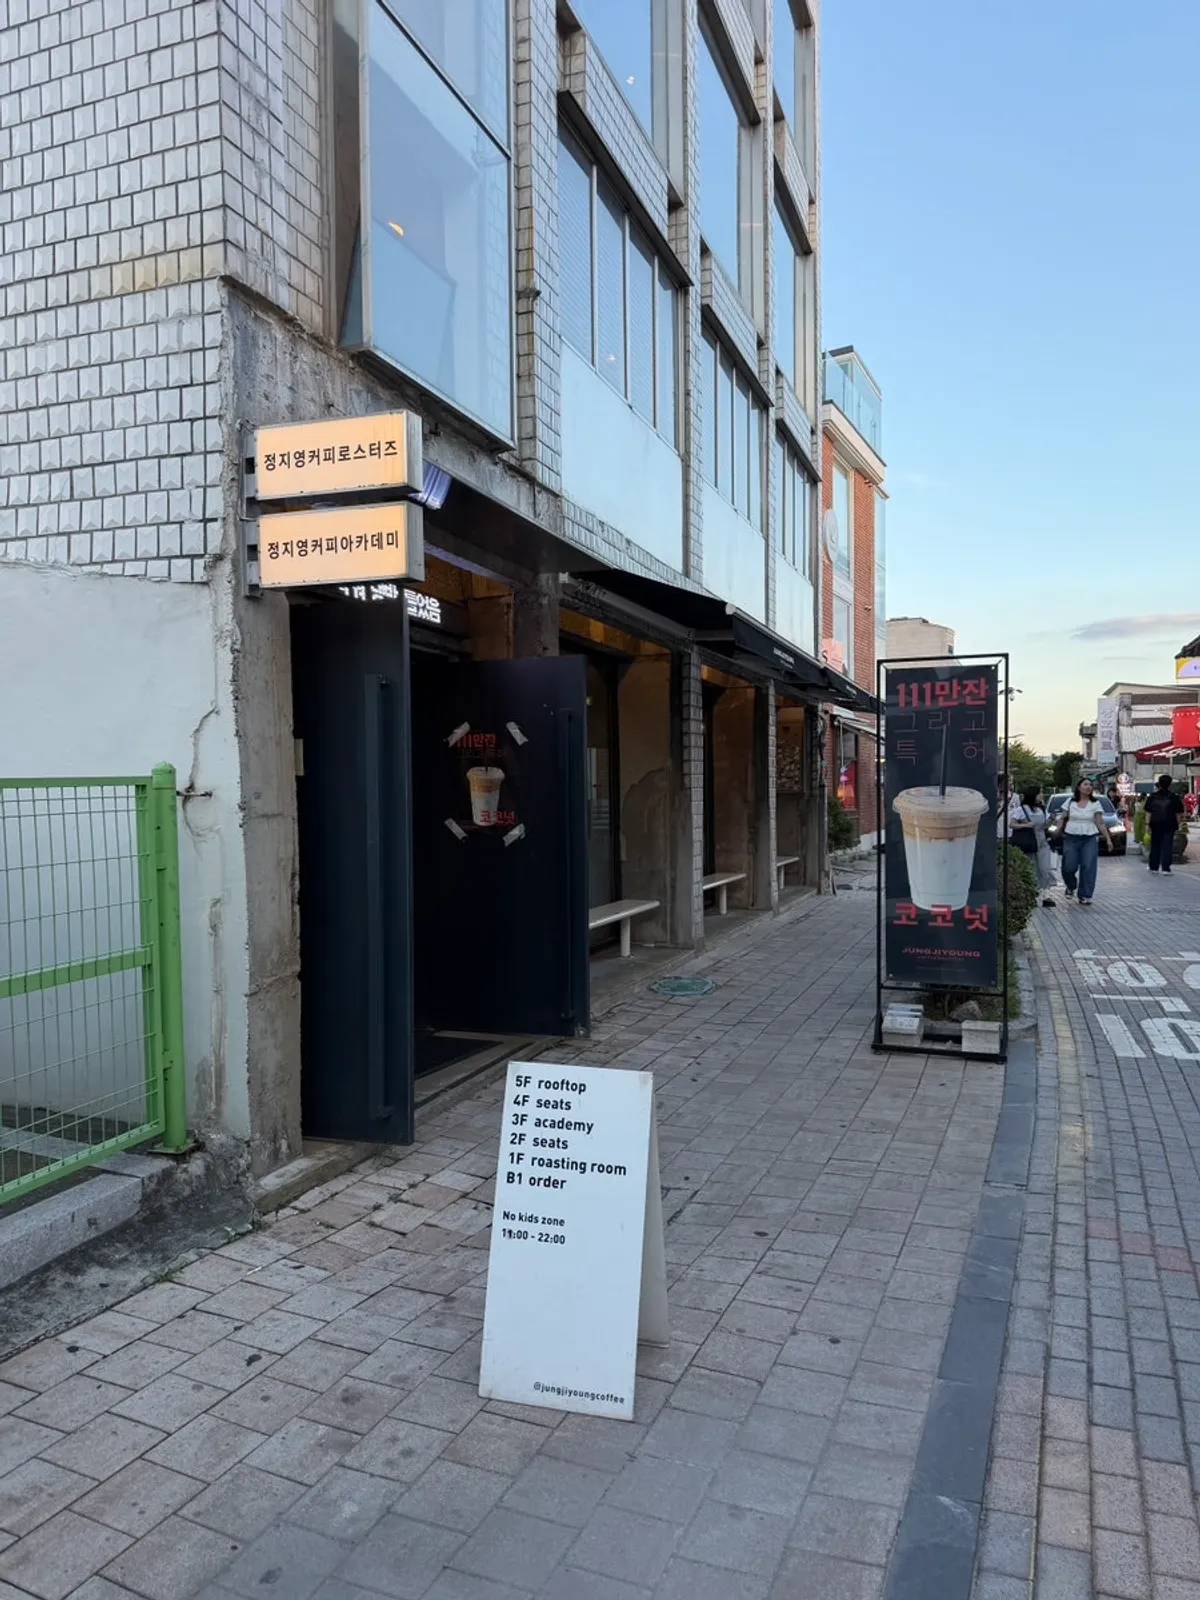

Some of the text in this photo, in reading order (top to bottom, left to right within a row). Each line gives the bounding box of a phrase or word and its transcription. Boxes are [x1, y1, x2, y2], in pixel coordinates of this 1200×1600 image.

[263, 440, 399, 472] 정지영커피로스터즈
[267, 530, 400, 560] 정지영커피아카데미
[896, 677, 989, 708] 111만잔
[893, 903, 989, 931] 코코넛
[902, 948, 981, 958] JUNGJIYOUNG
[515, 1075, 587, 1095] 5F rooftop
[513, 1094, 572, 1111] 4F seats
[511, 1113, 594, 1135] 3F academy
[509, 1132, 569, 1150] 2F seats
[508, 1152, 627, 1176] 1F roasting room
[506, 1171, 567, 1189] B1 order
[502, 1210, 566, 1227] No kids zone
[502, 1228, 529, 1241] 11:00
[537, 1231, 566, 1245] 22:00
[533, 1381, 626, 1404] @jungjiyoungcoffee
